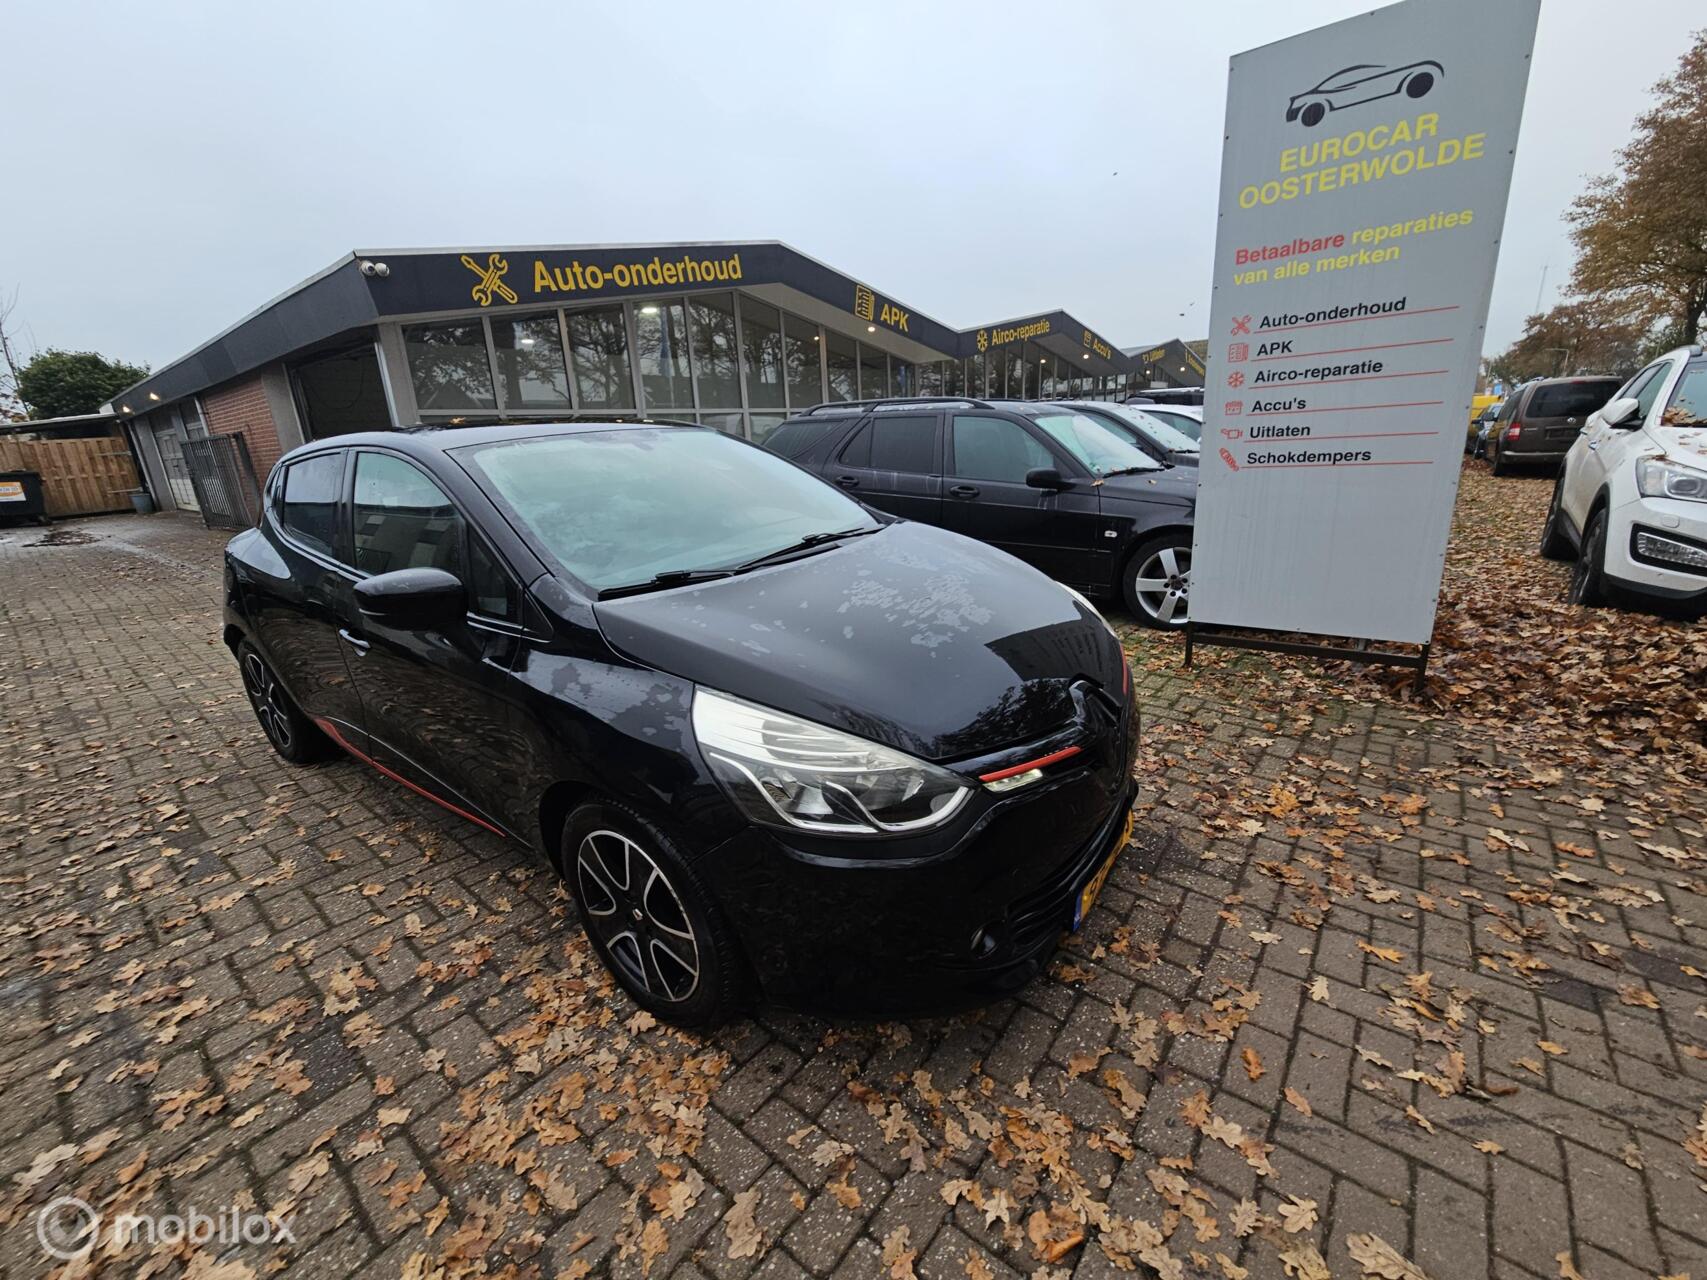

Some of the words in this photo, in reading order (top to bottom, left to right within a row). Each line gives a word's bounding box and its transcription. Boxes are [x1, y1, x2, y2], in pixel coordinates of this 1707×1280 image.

[1279, 112, 1439, 173] EUROCAR
[1239, 132, 1486, 209] OOSTERWOLDE
[1235, 234, 1345, 265] Betaalbare
[1352, 209, 1474, 245] reparaties
[533, 253, 742, 293] Auto-onderhoud
[1233, 268, 1268, 286] van
[1273, 258, 1309, 280] alle
[1316, 246, 1400, 273] merken
[880, 303, 910, 333] APK
[1259, 297, 1407, 329] Auto-onderhoud
[991, 318, 1051, 346] Airco-reparatie
[1256, 340, 1293, 357] APK
[1254, 360, 1383, 384] Airco-reparatie
[1251, 397, 1307, 413] Accu's
[1249, 425, 1311, 440] Uitlaten
[1247, 449, 1372, 466] Schokdempers
